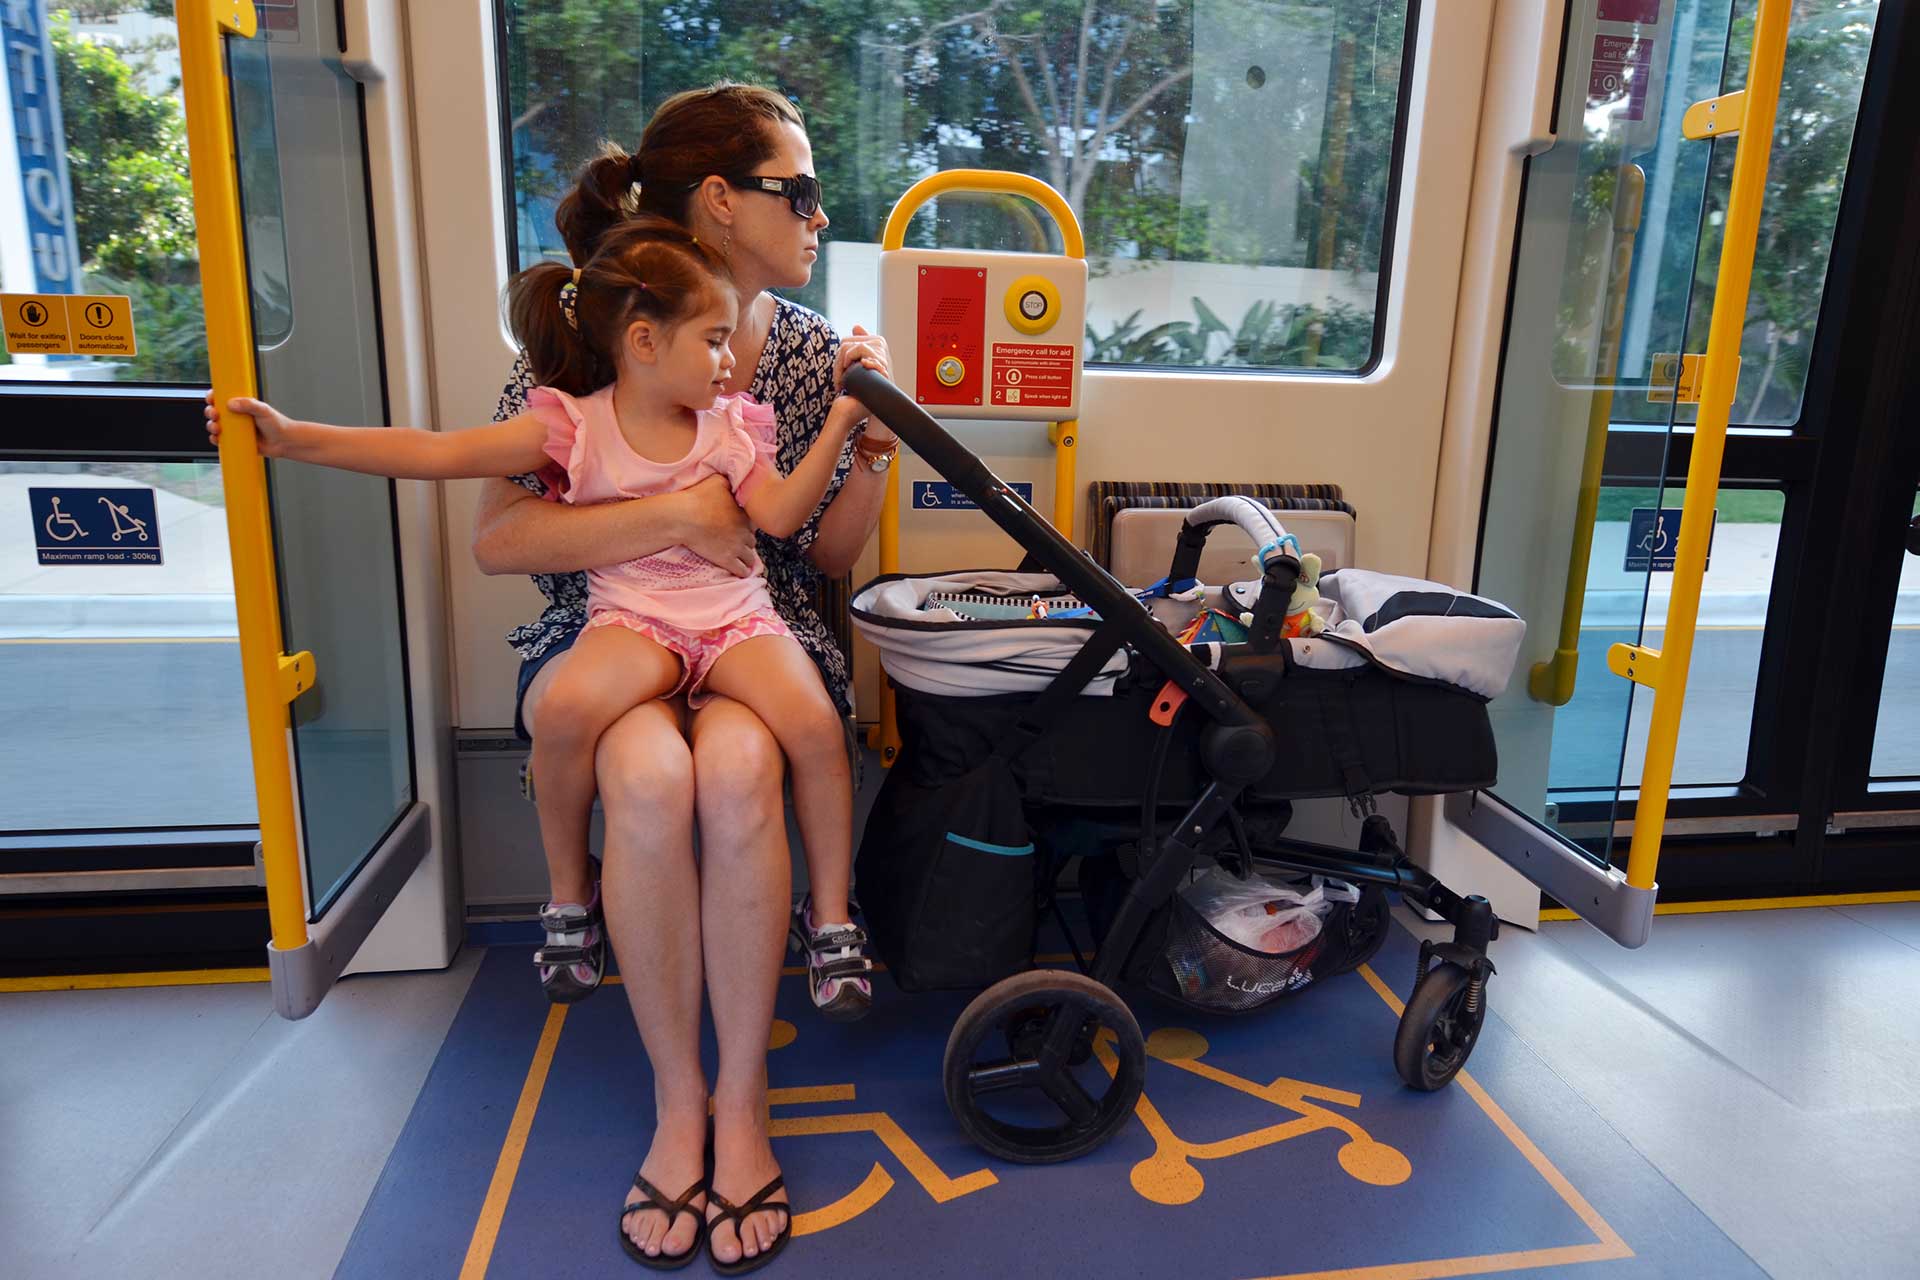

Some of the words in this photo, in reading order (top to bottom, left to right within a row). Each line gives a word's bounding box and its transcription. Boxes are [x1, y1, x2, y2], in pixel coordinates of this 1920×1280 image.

[1025, 301, 1043, 309] STOP
[9, 332, 28, 340] Wait
[28, 332, 39, 340] for
[40, 333, 66, 341] exiting
[79, 333, 102, 341] Doors
[103, 333, 124, 341] close
[78, 343, 128, 351] automatically
[996, 346, 1035, 356] Emergency
[996, 371, 1001, 380] 1
[995, 390, 1002, 399] 2
[41, 552, 81, 560] Maximum
[84, 553, 105, 561] ramp
[106, 552, 125, 560] load
[131, 552, 157, 561] 300kg
[1657, 561, 1672, 569] ramp
